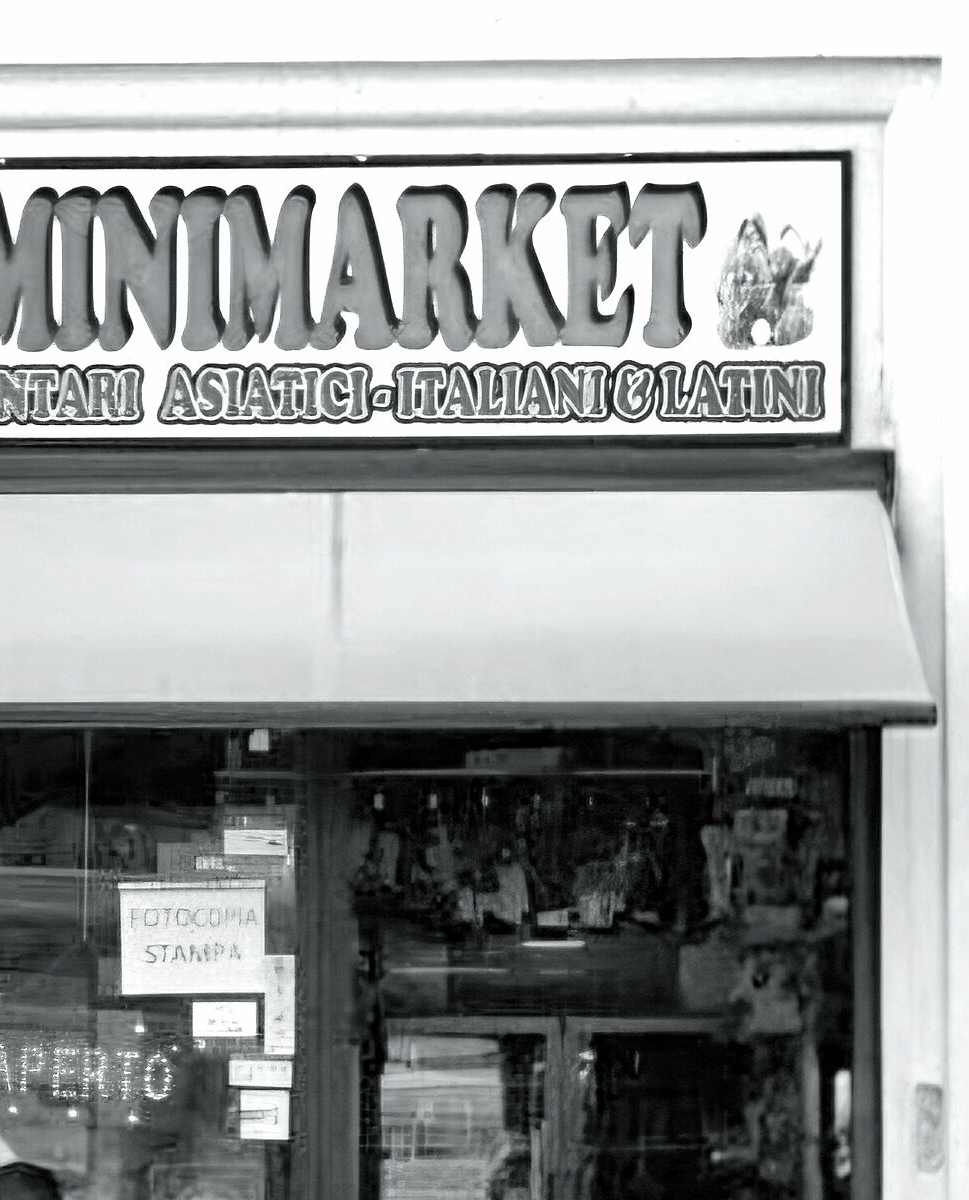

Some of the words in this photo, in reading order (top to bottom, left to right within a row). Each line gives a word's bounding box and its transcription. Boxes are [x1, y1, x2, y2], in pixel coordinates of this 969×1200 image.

[157, 362, 373, 424] ASIATICI
[393, 362, 612, 423] ITALIANI
[656, 360, 826, 422] LATINI
